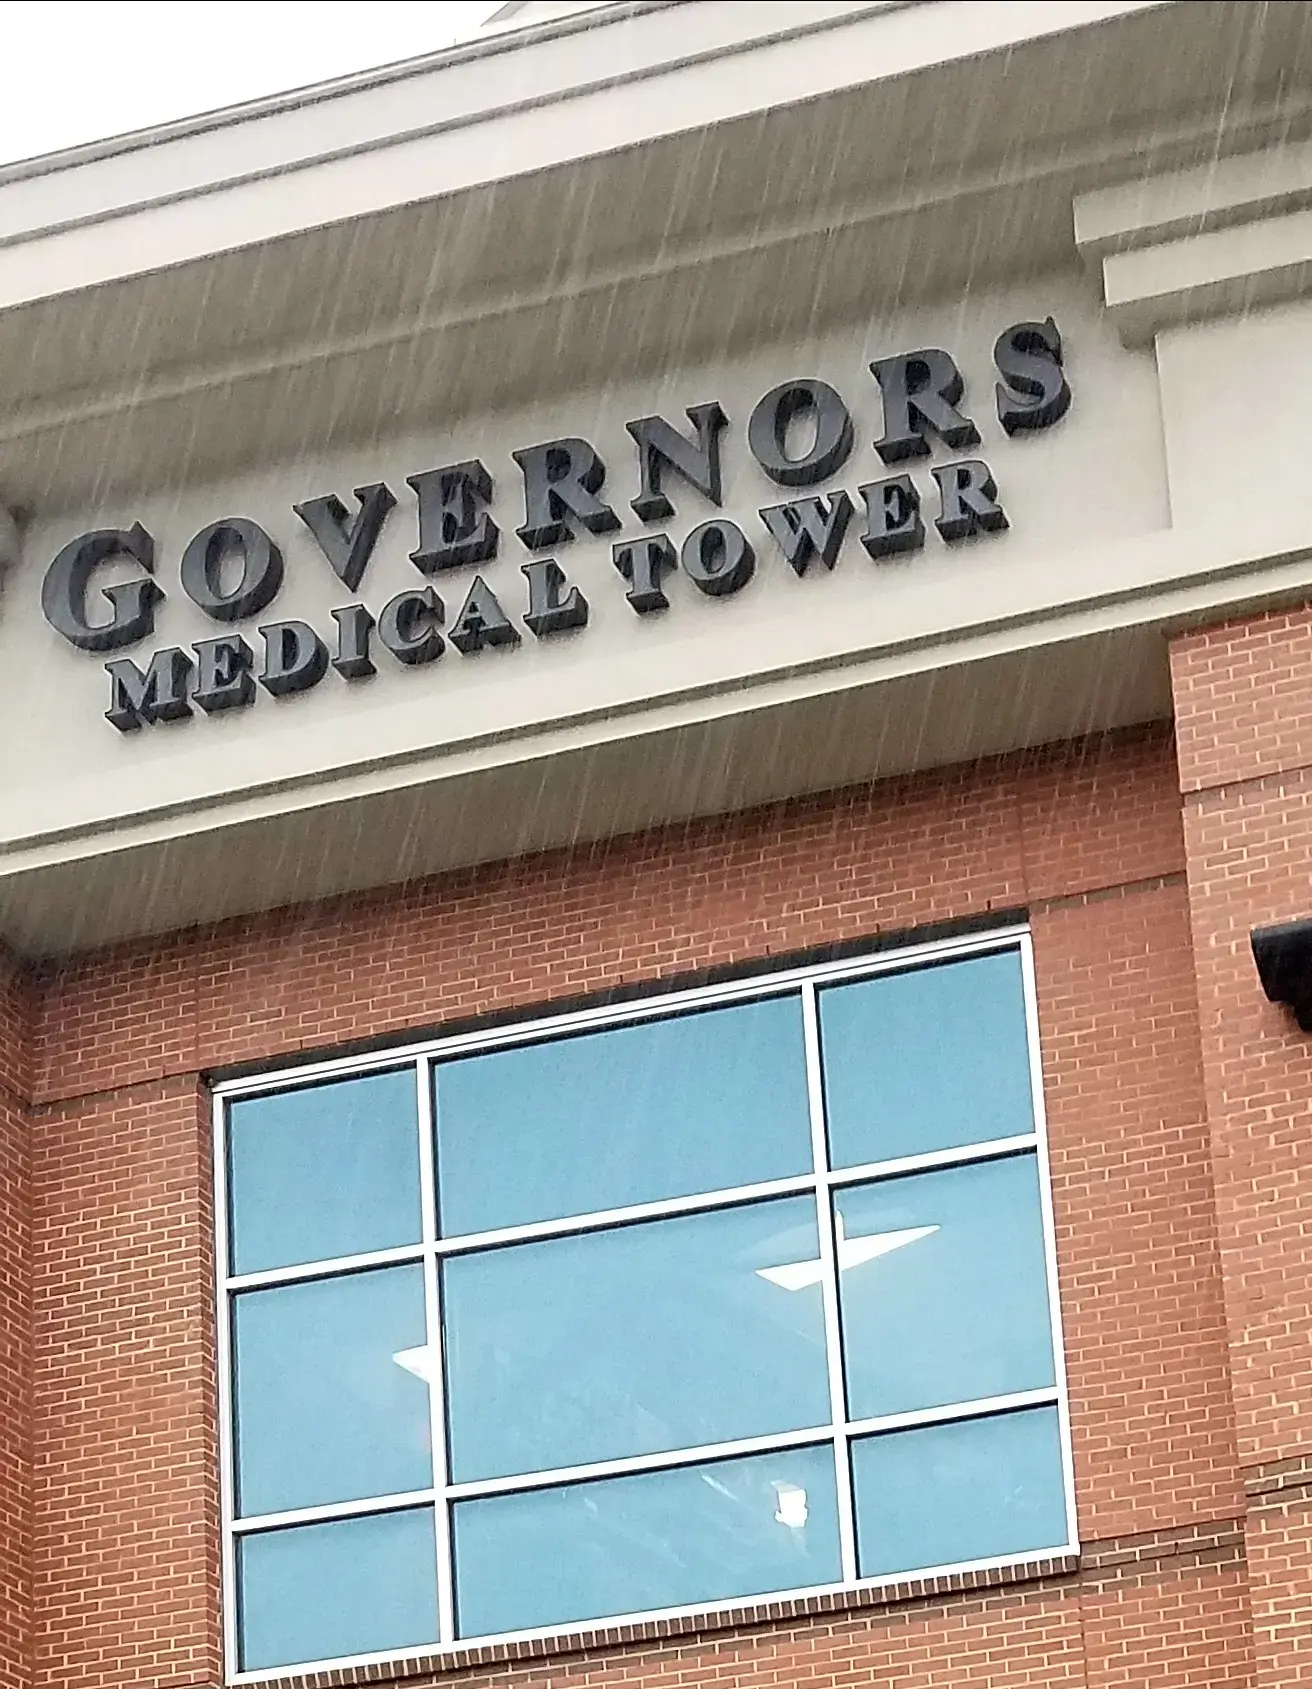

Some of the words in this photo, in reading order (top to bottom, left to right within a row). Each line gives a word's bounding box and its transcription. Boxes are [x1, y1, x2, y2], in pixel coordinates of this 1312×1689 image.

[41, 316, 1071, 652] GOVERNORS
[103, 560, 589, 731] MEDICAL
[612, 460, 1009, 612] TOWER
